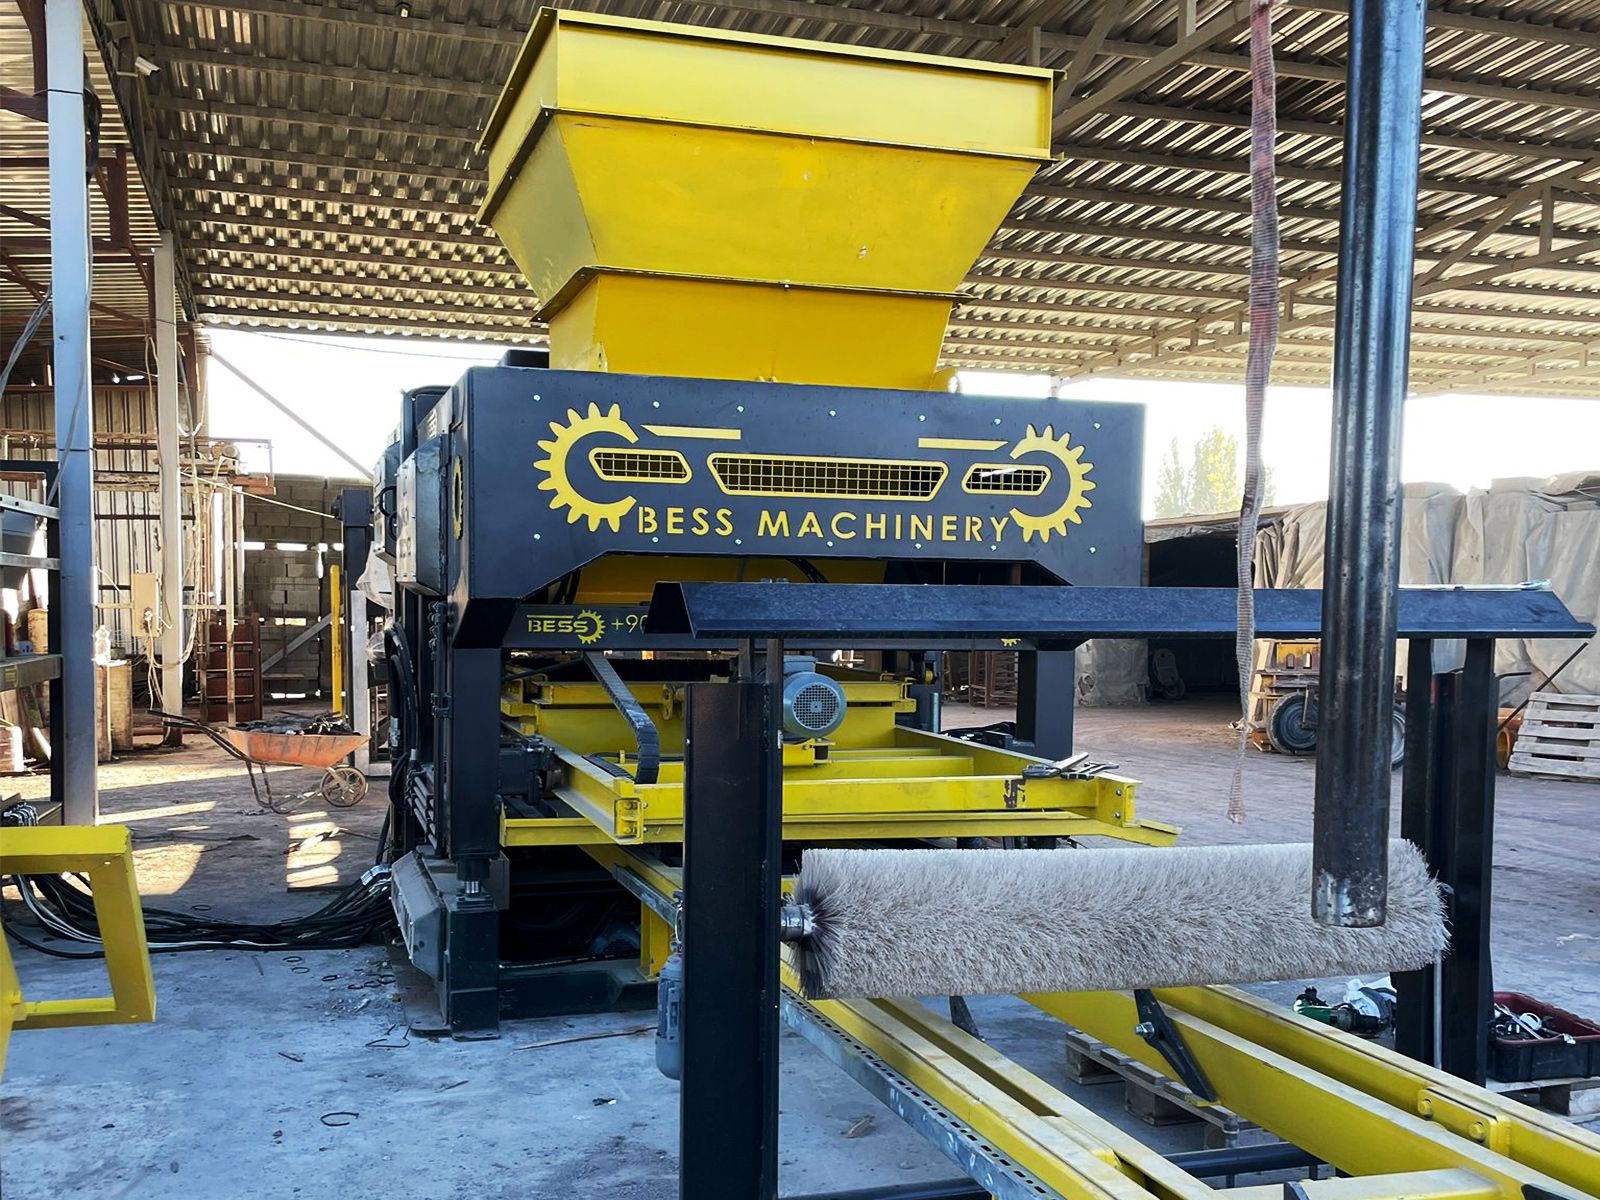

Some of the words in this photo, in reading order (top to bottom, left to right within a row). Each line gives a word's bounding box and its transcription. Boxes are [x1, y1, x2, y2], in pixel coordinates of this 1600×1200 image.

[638, 506, 734, 536] BESS
[757, 510, 1009, 543] MACHINERY
[527, 620, 589, 633] BESS
